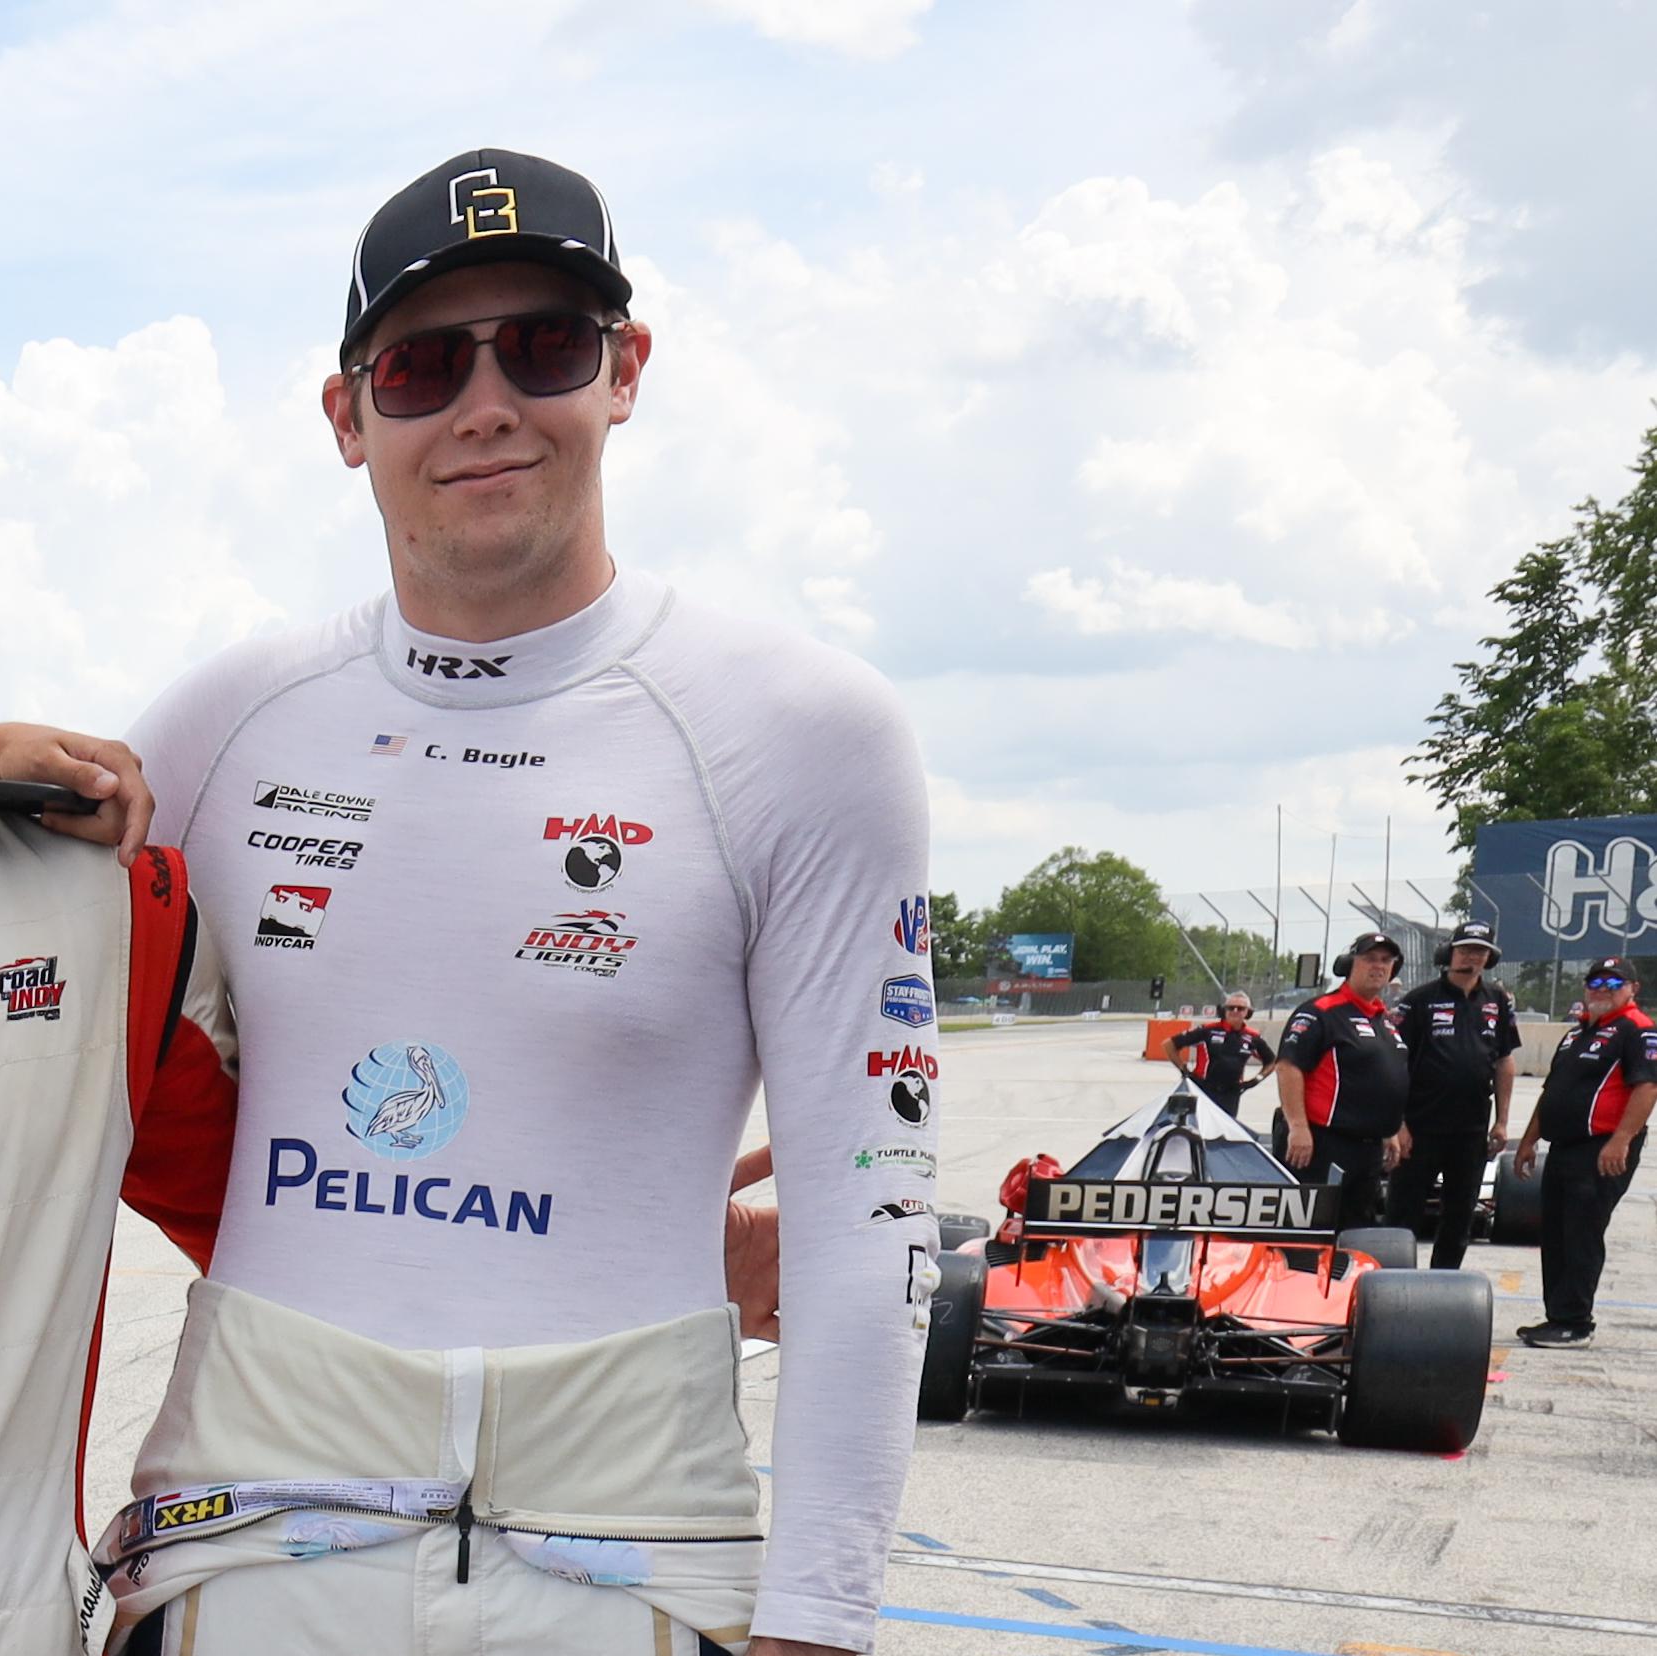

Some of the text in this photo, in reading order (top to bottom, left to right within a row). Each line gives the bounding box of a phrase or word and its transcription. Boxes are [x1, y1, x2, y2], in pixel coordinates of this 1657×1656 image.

[406, 647, 515, 680] HRX
[424, 743, 546, 769] C. Bogle
[279, 786, 376, 808] DALE COYNE
[274, 802, 371, 822] RACING
[543, 813, 655, 845] HMD
[247, 830, 364, 857] COOPER
[295, 854, 357, 870] TIRES
[254, 935, 315, 950] INDYCAR
[524, 931, 637, 953] INDY
[514, 949, 628, 968] LIGHTS
[7, 979, 67, 1012] INDY
[867, 1044, 938, 1080] HMD
[877, 1149, 918, 1158] TURTLE
[265, 1137, 553, 1235] PELICAN
[1047, 1182, 1319, 1228] PEDERSEN
[155, 1493, 227, 1531] HRX
